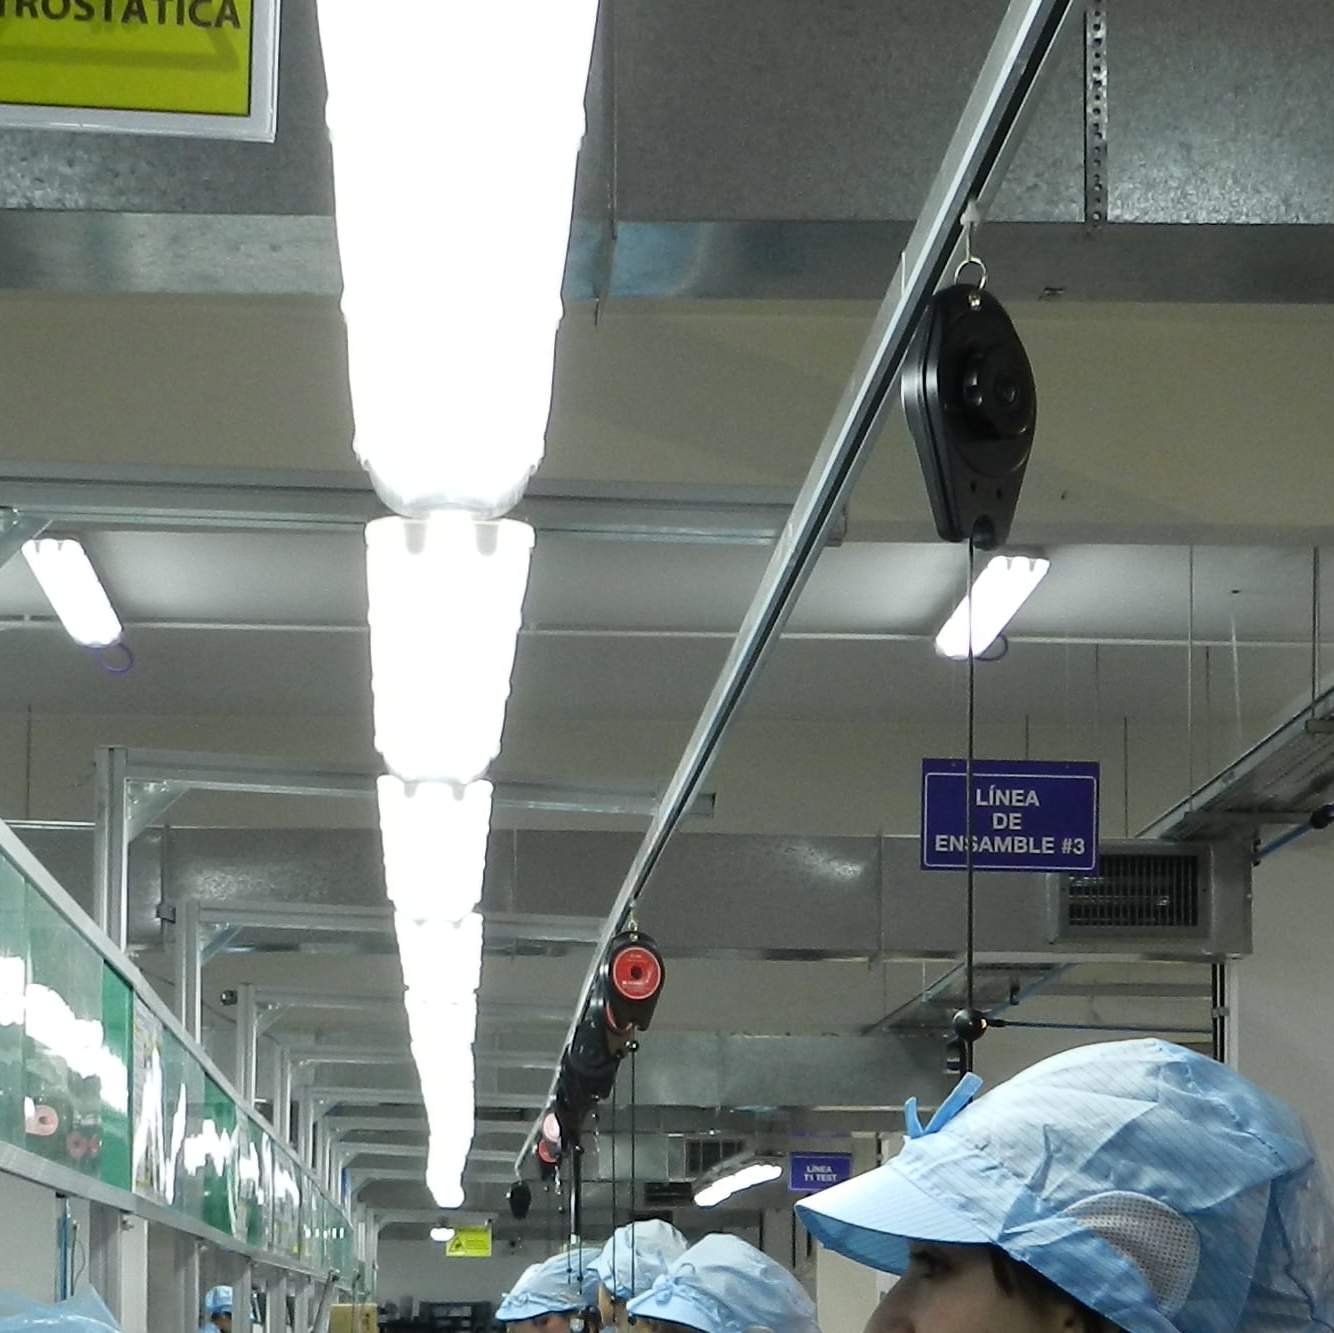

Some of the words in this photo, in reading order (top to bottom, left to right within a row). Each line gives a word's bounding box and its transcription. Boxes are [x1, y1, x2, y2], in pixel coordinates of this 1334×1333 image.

[976, 785, 1040, 807] LÍNEA
[992, 812, 1022, 830] DE
[935, 835, 1055, 854] ENSAMBLE
[1061, 837, 1085, 855] #3
[816, 1174, 837, 1182] TEST
